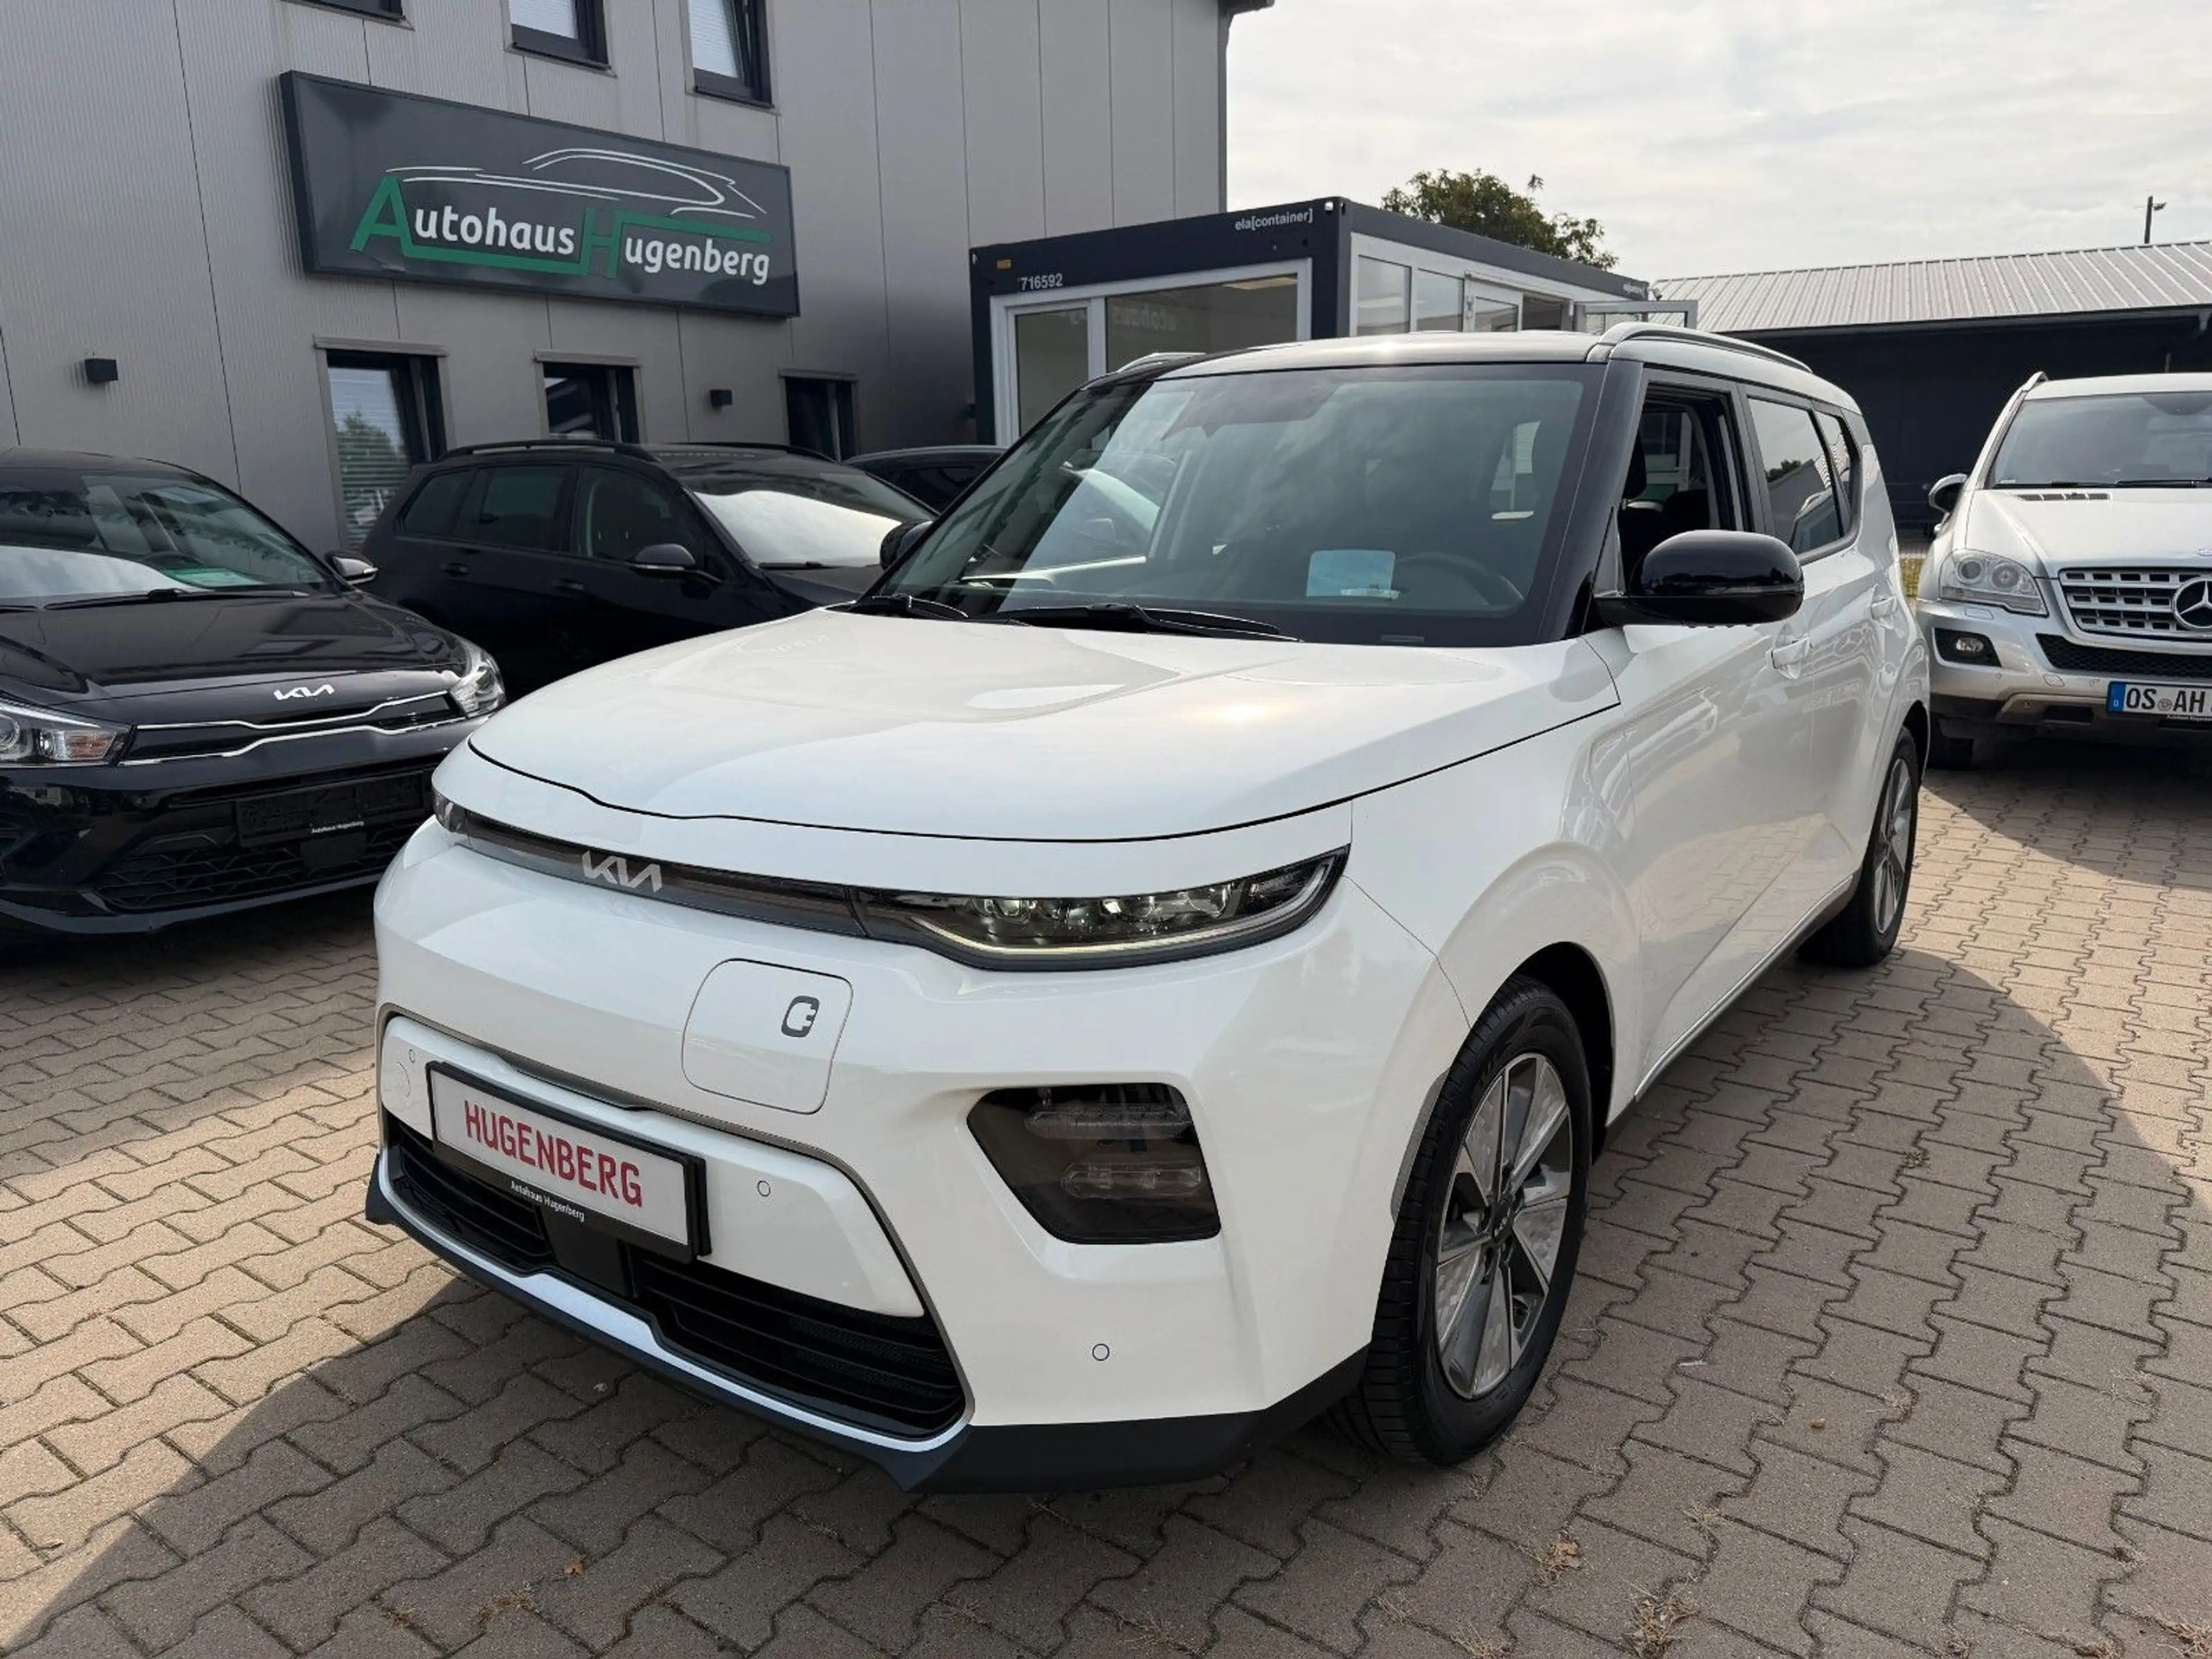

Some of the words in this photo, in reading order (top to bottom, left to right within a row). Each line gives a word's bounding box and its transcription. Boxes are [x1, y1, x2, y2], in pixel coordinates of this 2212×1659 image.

[1235, 207, 1313, 230] ela[container]
[349, 176, 576, 255] Autohaus
[581, 205, 771, 286] Hugenberg
[1020, 272, 1063, 291] 716592
[2113, 699, 2119, 707] D
[2126, 687, 2157, 710] OS
[2173, 690, 2206, 713] AH
[582, 850, 662, 893] KIA
[464, 1100, 642, 1207] HUGENBERG
[510, 1180, 543, 1203] Autohaus
